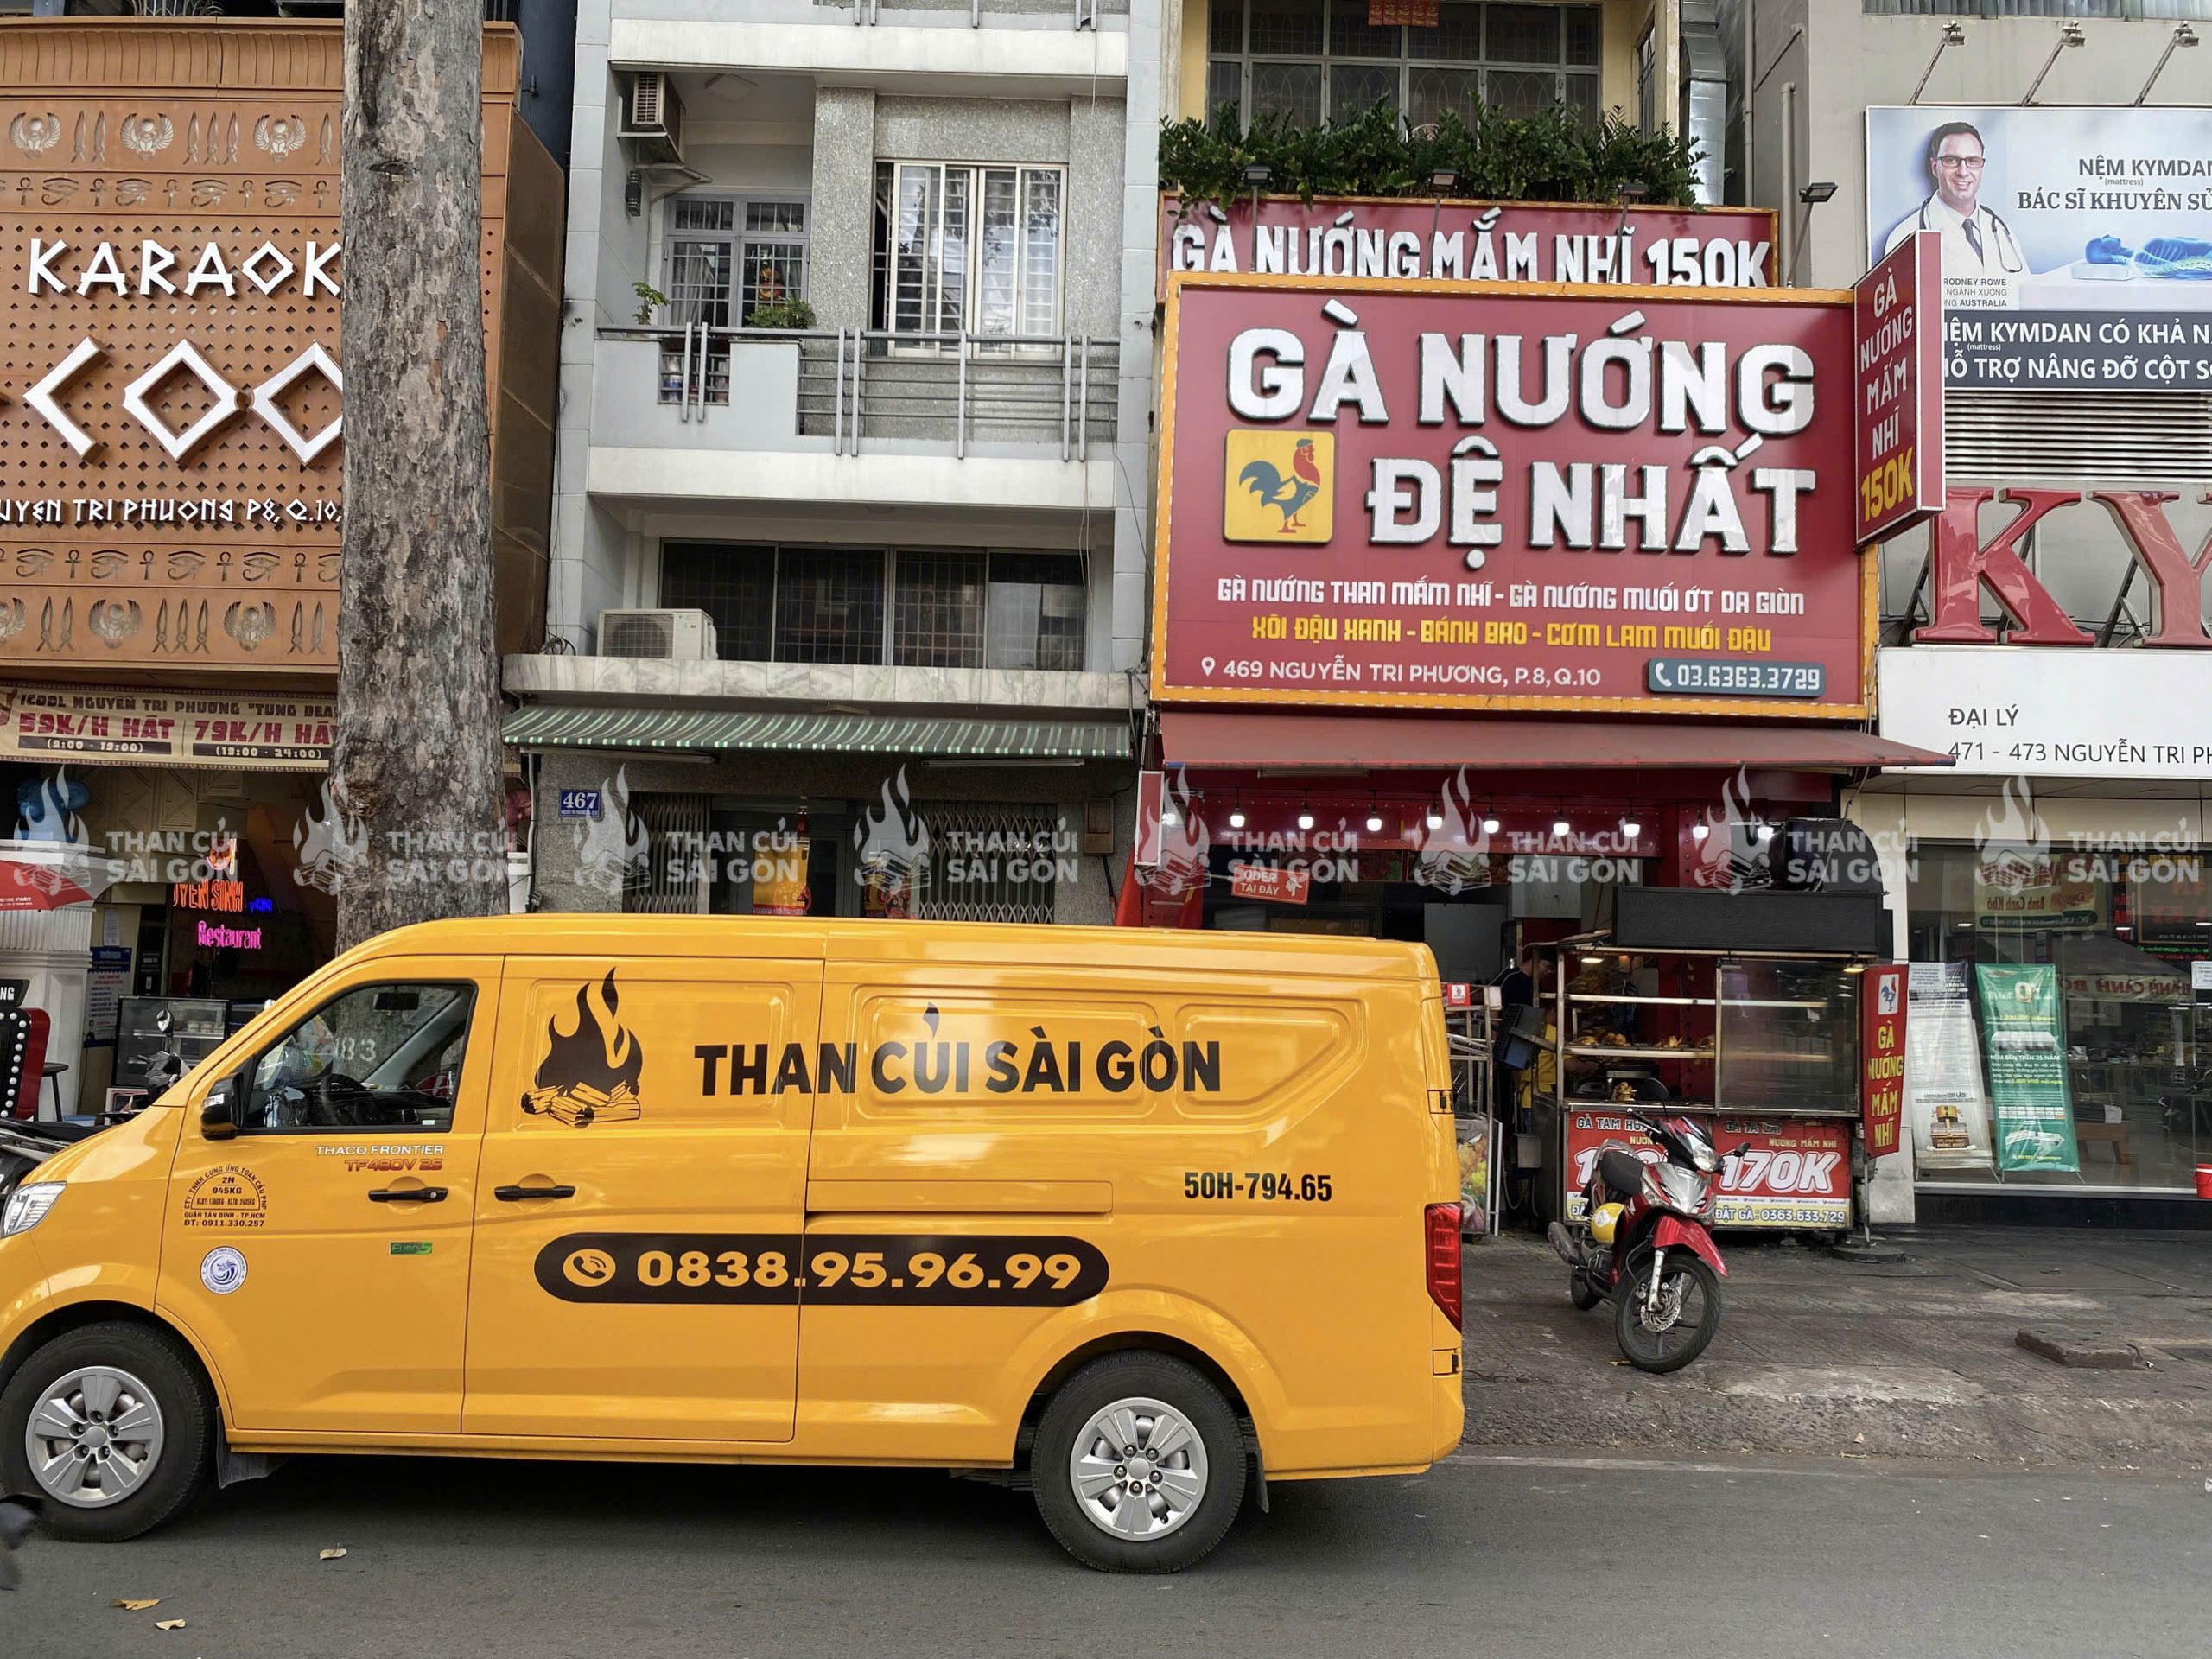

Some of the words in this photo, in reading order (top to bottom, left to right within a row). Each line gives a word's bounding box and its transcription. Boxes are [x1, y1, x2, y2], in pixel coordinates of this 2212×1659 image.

[2079, 155, 2125, 180] NỆM
[2104, 178, 2144, 187] (mattress)
[2018, 186, 2060, 210] BÁC
[2065, 188, 2086, 210] SĨ
[2090, 188, 2182, 211] KHUYÊN
[1173, 205, 1238, 273] GÀ
[1255, 210, 1421, 279] NƯỚNG
[1432, 207, 1538, 283] MẮM
[1645, 238, 1770, 288] 150K
[1873, 267, 1897, 318] GÀ
[1860, 306, 1912, 373] NƯỚNG
[1944, 317, 1982, 346] ỆM
[1991, 322, 2091, 344] KYMDAN
[2098, 318, 2130, 344] CÓ
[2138, 318, 2186, 344] KHẢ
[2193, 323, 2212, 344] N
[1227, 297, 1389, 424] GÀ
[1417, 310, 1815, 435] NƯỚNG
[1944, 349, 1967, 378] Ỗ
[1974, 356, 2022, 384] TRỢ
[2028, 353, 2095, 378] NÂNG
[2101, 354, 2139, 379] ĐỠ
[2144, 354, 2190, 385] CỘT
[2196, 359, 2212, 380] S
[1860, 447, 1913, 522] 150K
[73, 499, 113, 522] TRI
[1366, 435, 1504, 571] ĐỆ
[1529, 432, 1816, 557] NHẤT
[1217, 574, 1246, 601] GÀ
[1251, 575, 1325, 603] NƯỚNG
[1330, 581, 1386, 605] THAN
[1509, 581, 1538, 607] GÀ
[1543, 581, 1618, 610] NƯỚNG
[1623, 581, 1679, 612] MUỐI
[1685, 585, 1714, 613] ỚT
[1721, 590, 1750, 614] DA
[1755, 588, 1804, 615] GIÒN
[1252, 613, 1287, 640] XÔI
[1294, 614, 1338, 644] ĐẬU
[1344, 617, 1402, 643] XANH
[1421, 615, 1478, 644] BÁNH
[1484, 620, 1527, 646] BAO
[1546, 622, 1599, 647] CƠM
[1606, 624, 1657, 649] LAM
[1663, 620, 1721, 651] MUỐI
[1726, 626, 1770, 654] ĐẬU
[1223, 659, 1263, 678] 469
[1269, 654, 1361, 681] NGUYỄN
[1369, 664, 1403, 682] TRI
[1409, 664, 1508, 688] PHƯƠNG,
[1678, 664, 1821, 690] 03.6363.3729
[73, 695, 136, 713] NGUYỄN
[142, 698, 168, 714] TRI
[175, 699, 240, 716] PHƯƠNG
[303, 704, 337, 719] DEA
[1948, 708, 1987, 729] ĐẠI
[1996, 703, 2019, 726] LÝ
[19, 712, 109, 738] 59K/H
[122, 714, 175, 741] HÁT
[194, 720, 282, 745] 79K/H
[294, 722, 337, 747] HÁ
[1948, 741, 1985, 760] 471
[2009, 742, 2047, 762] 473
[2055, 737, 2146, 763] NGUYỄN
[2153, 745, 2185, 765] TRI
[562, 791, 598, 809] 467
[1244, 869, 1279, 883] ODER
[197, 920, 262, 950] Restaurant
[0, 986, 15, 1001] NG
[1878, 1020, 1895, 1050] GÀ
[694, 1042, 856, 1096] THAN
[985, 1026, 1081, 1093] SÀI
[1096, 1025, 1221, 1093] GÒN
[1868, 1052, 1904, 1080] NƯỚNG
[1576, 1113, 1593, 1129] GÀ
[1596, 1116, 1621, 1130] TAM
[315, 1145, 367, 1156] THACO
[371, 1145, 444, 1155] FRONTIER
[1719, 1149, 1841, 1192] 170K
[1184, 1170, 1332, 1203] 50H-794.65
[201, 1219, 264, 1228] 0911.330.257
[1761, 1209, 1846, 1223] 0363.633.729
[636, 1247, 1083, 1292] 0838.95.96.99
